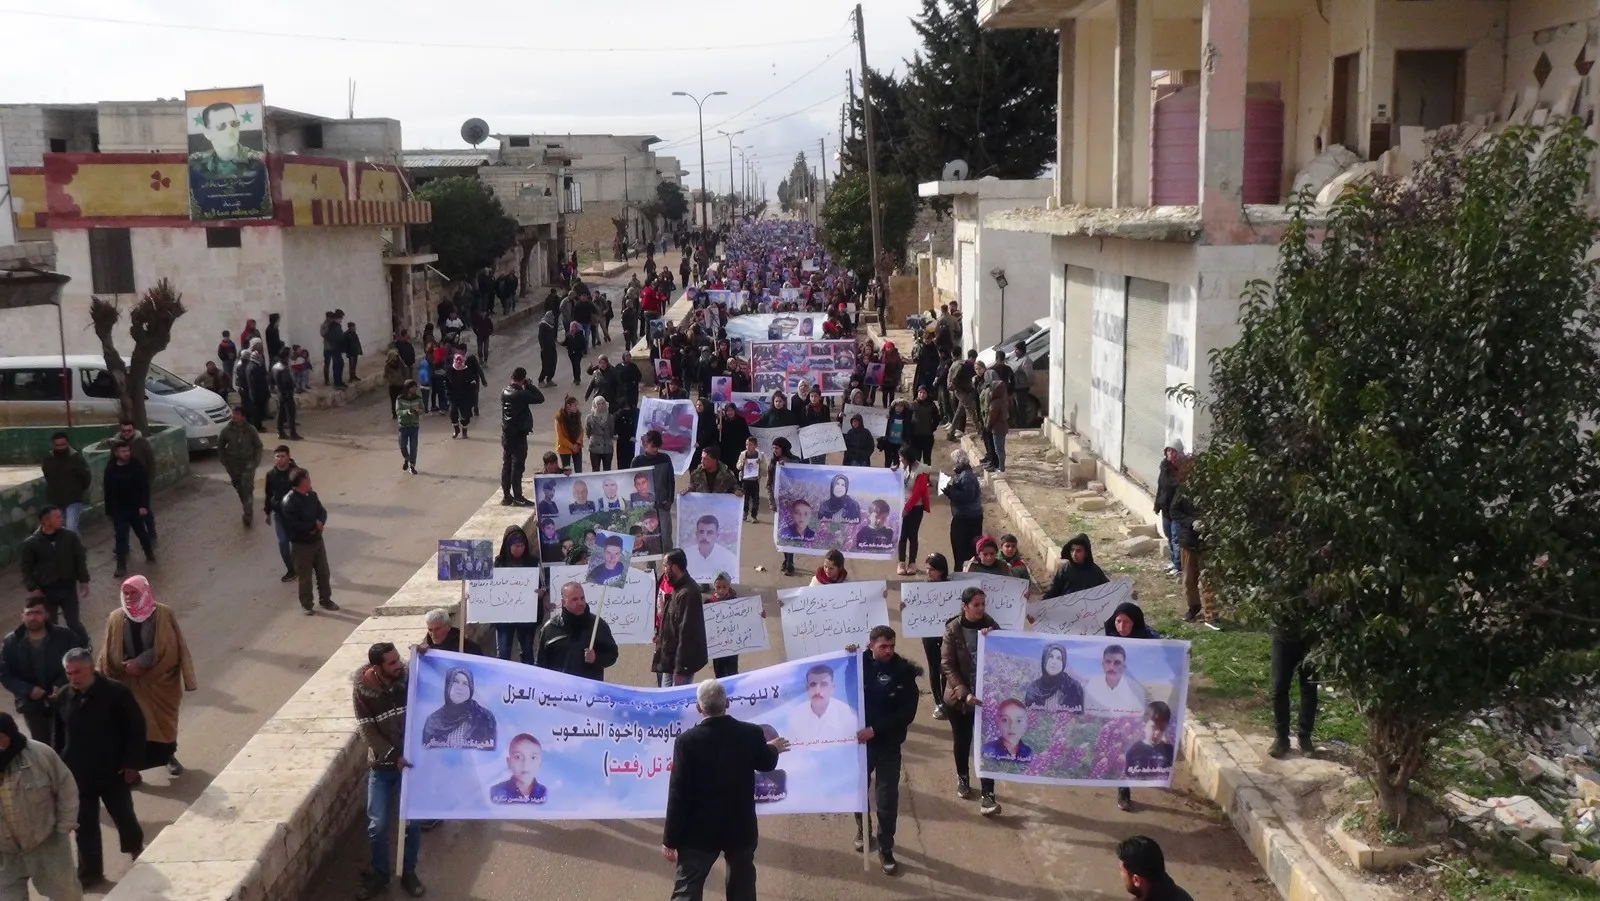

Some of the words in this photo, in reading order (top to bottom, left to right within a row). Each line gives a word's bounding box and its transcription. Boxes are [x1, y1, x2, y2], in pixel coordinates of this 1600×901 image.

[981, 580, 1007, 593] أردوغا
[502, 684, 535, 705] العزل
[772, 685, 780, 699] لا
[551, 718, 604, 742] الشعوب
[607, 721, 643, 743] واخوة
[647, 721, 682, 743] قاومة
[647, 757, 662, 777] تل
